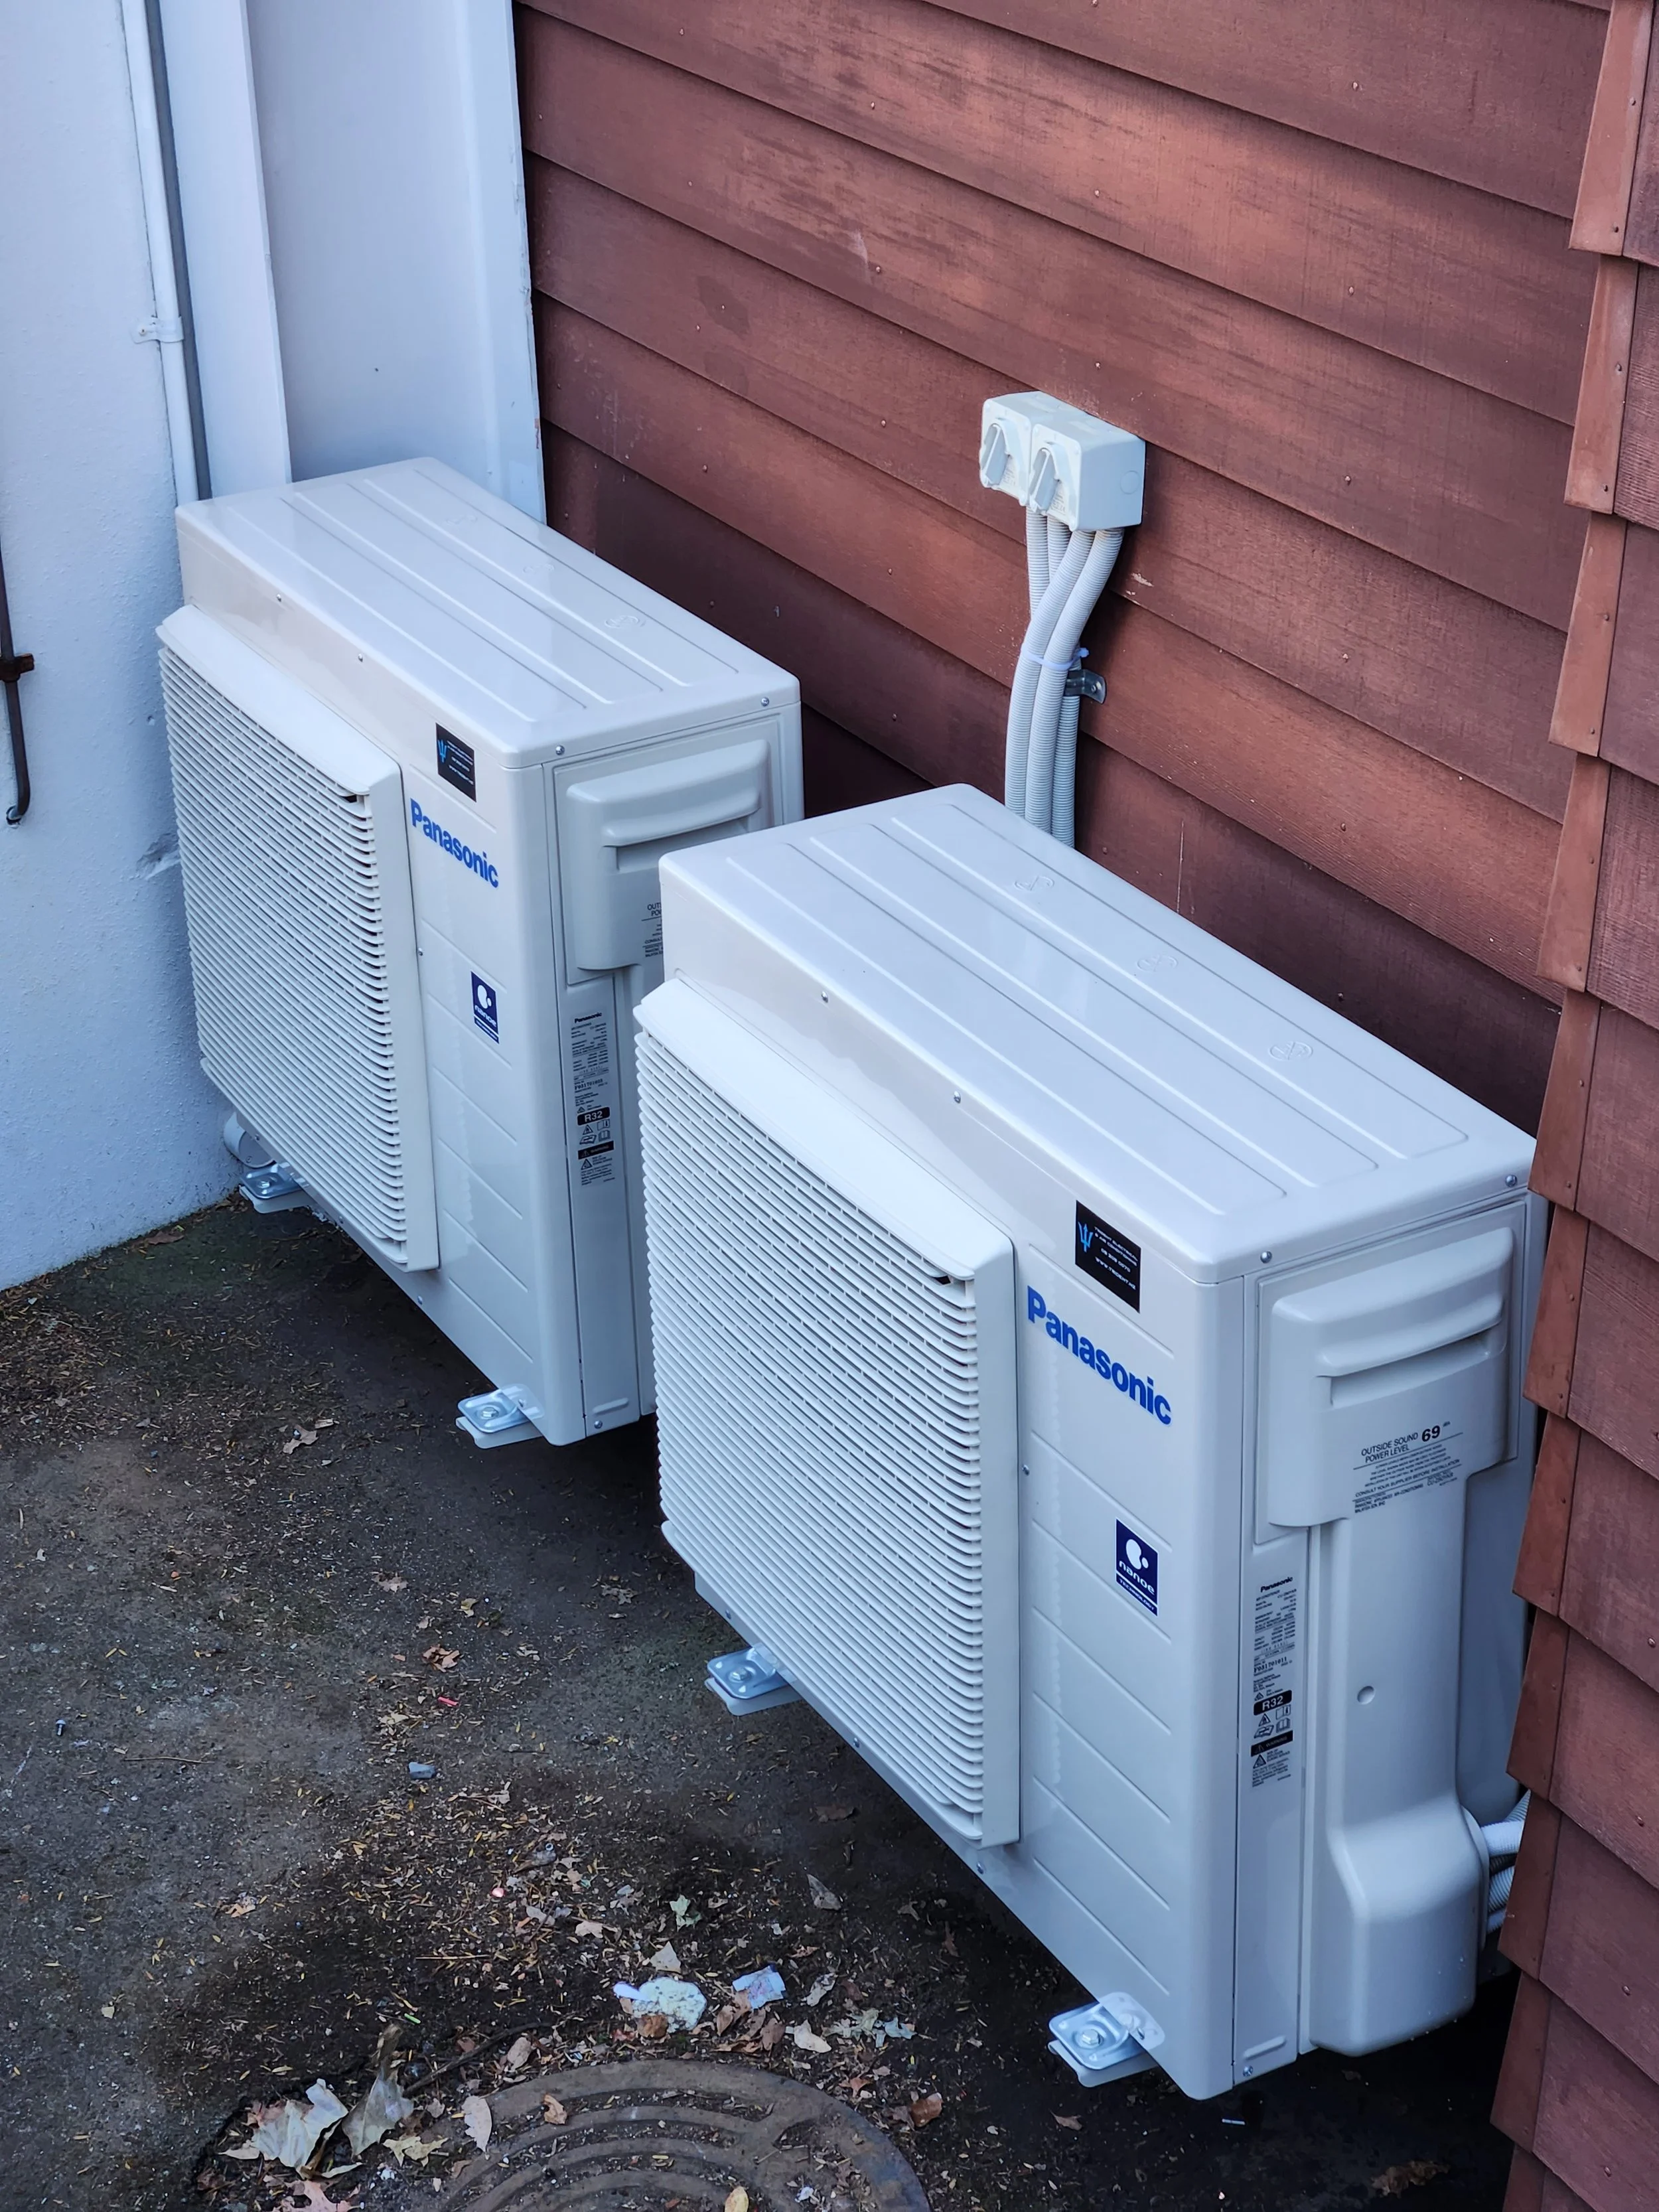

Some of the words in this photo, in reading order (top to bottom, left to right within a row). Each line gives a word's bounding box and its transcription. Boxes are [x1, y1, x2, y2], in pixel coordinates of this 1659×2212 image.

[410, 798, 498, 888] Panasonic
[474, 1005, 496, 1027] nanoe
[575, 1012, 602, 1023] Panasonic
[584, 1111, 603, 1122] R32
[1027, 1285, 1171, 1425] Panasonic
[1361, 1441, 1393, 1456] OUTSIDE
[1394, 1432, 1419, 1446] SOUND
[1421, 1425, 1441, 1442] 69
[1365, 1449, 1390, 1463] POWER
[1390, 1444, 1409, 1456] LEVEL
[1356, 1487, 1376, 1497] CONSULT
[1119, 1560, 1155, 1595] nanoe
[1261, 1577, 1293, 1593] Panasonic
[1262, 1696, 1283, 1711] R32
